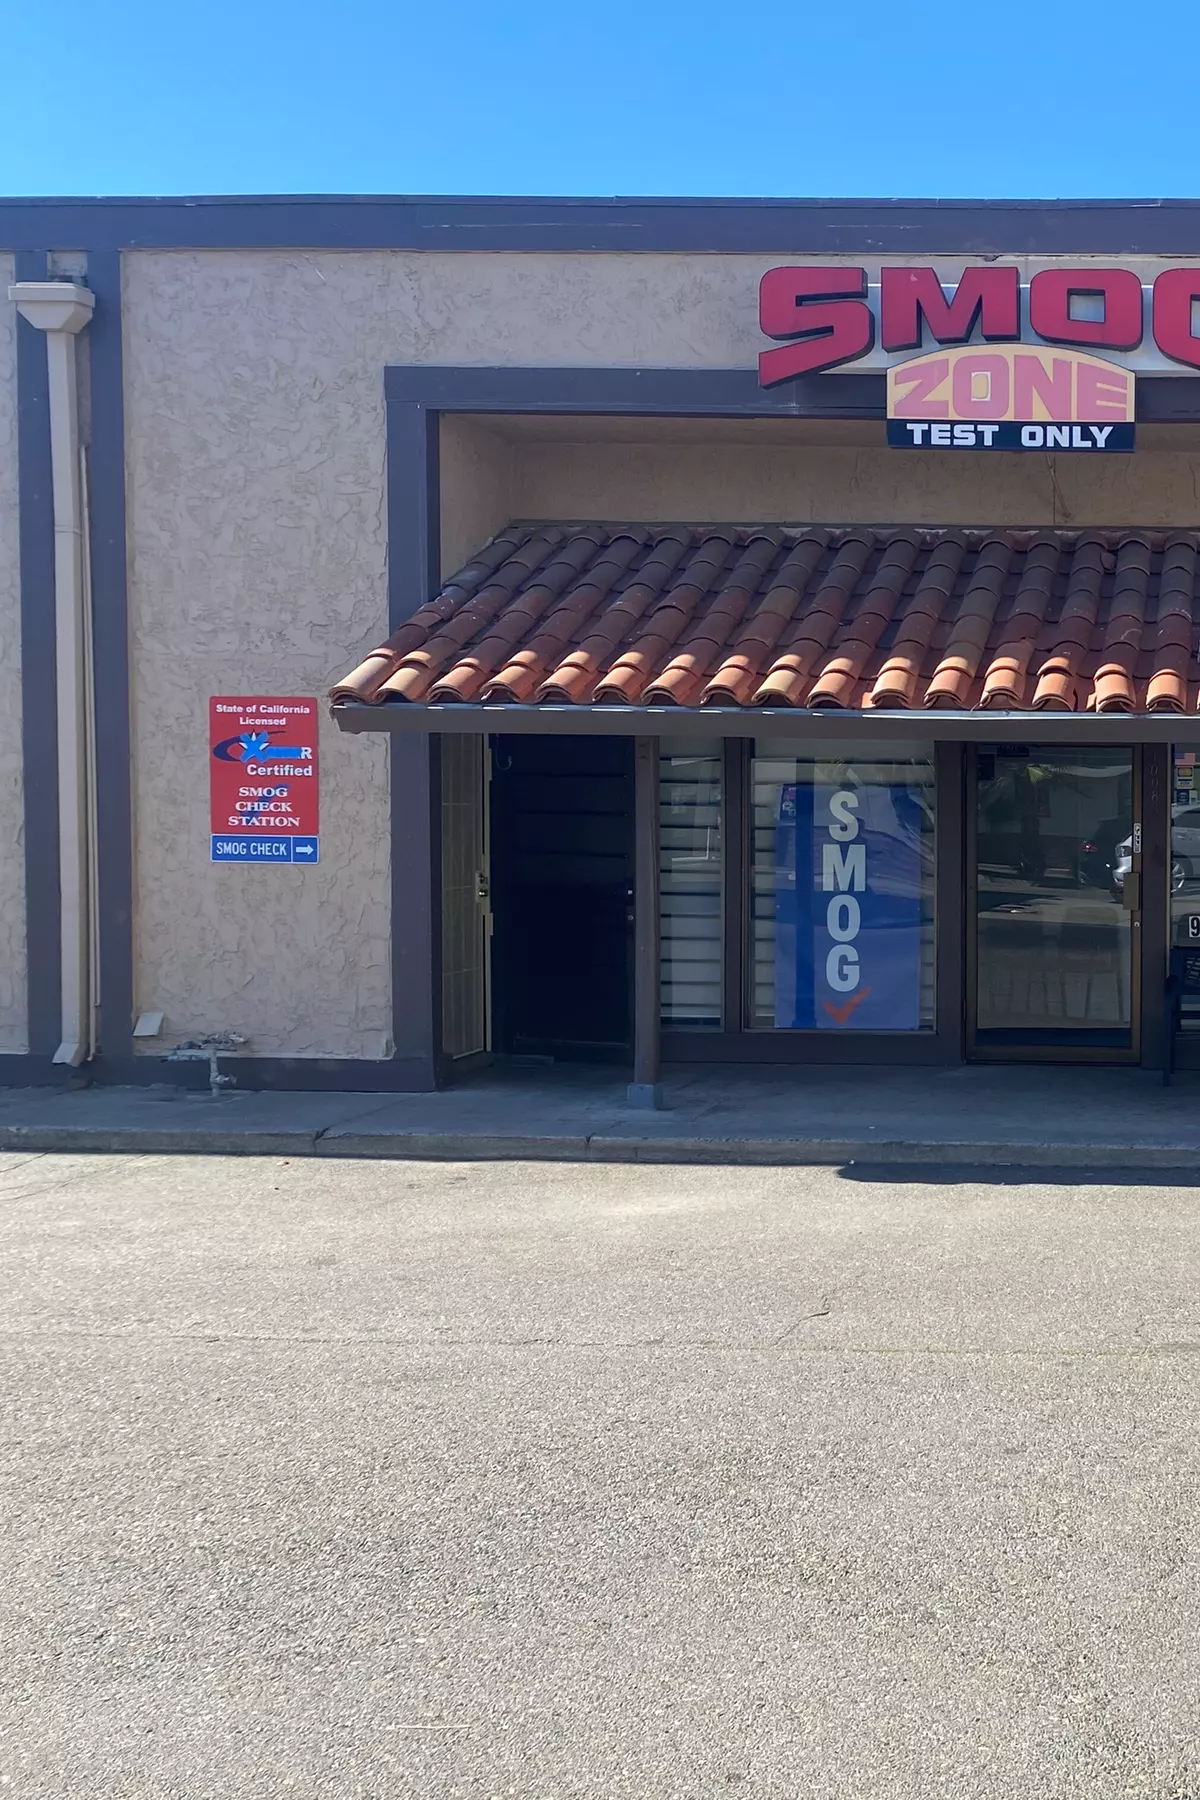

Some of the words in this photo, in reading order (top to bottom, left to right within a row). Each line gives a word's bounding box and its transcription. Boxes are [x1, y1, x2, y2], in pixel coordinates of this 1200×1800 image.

[893, 354, 1128, 421] ZONE
[906, 423, 999, 447] TEST
[1021, 425, 1114, 449] ONLY
[216, 704, 243, 713] State
[246, 705, 257, 713] of
[259, 705, 310, 714] California
[239, 717, 286, 726] Licensed
[247, 764, 313, 776] Certified
[238, 786, 289, 797] SMOG
[235, 801, 293, 812] CHECK
[227, 815, 301, 827] STATION
[216, 842, 247, 854] SMOG
[250, 842, 287, 856] CHECK
[822, 791, 867, 992] SMOG
